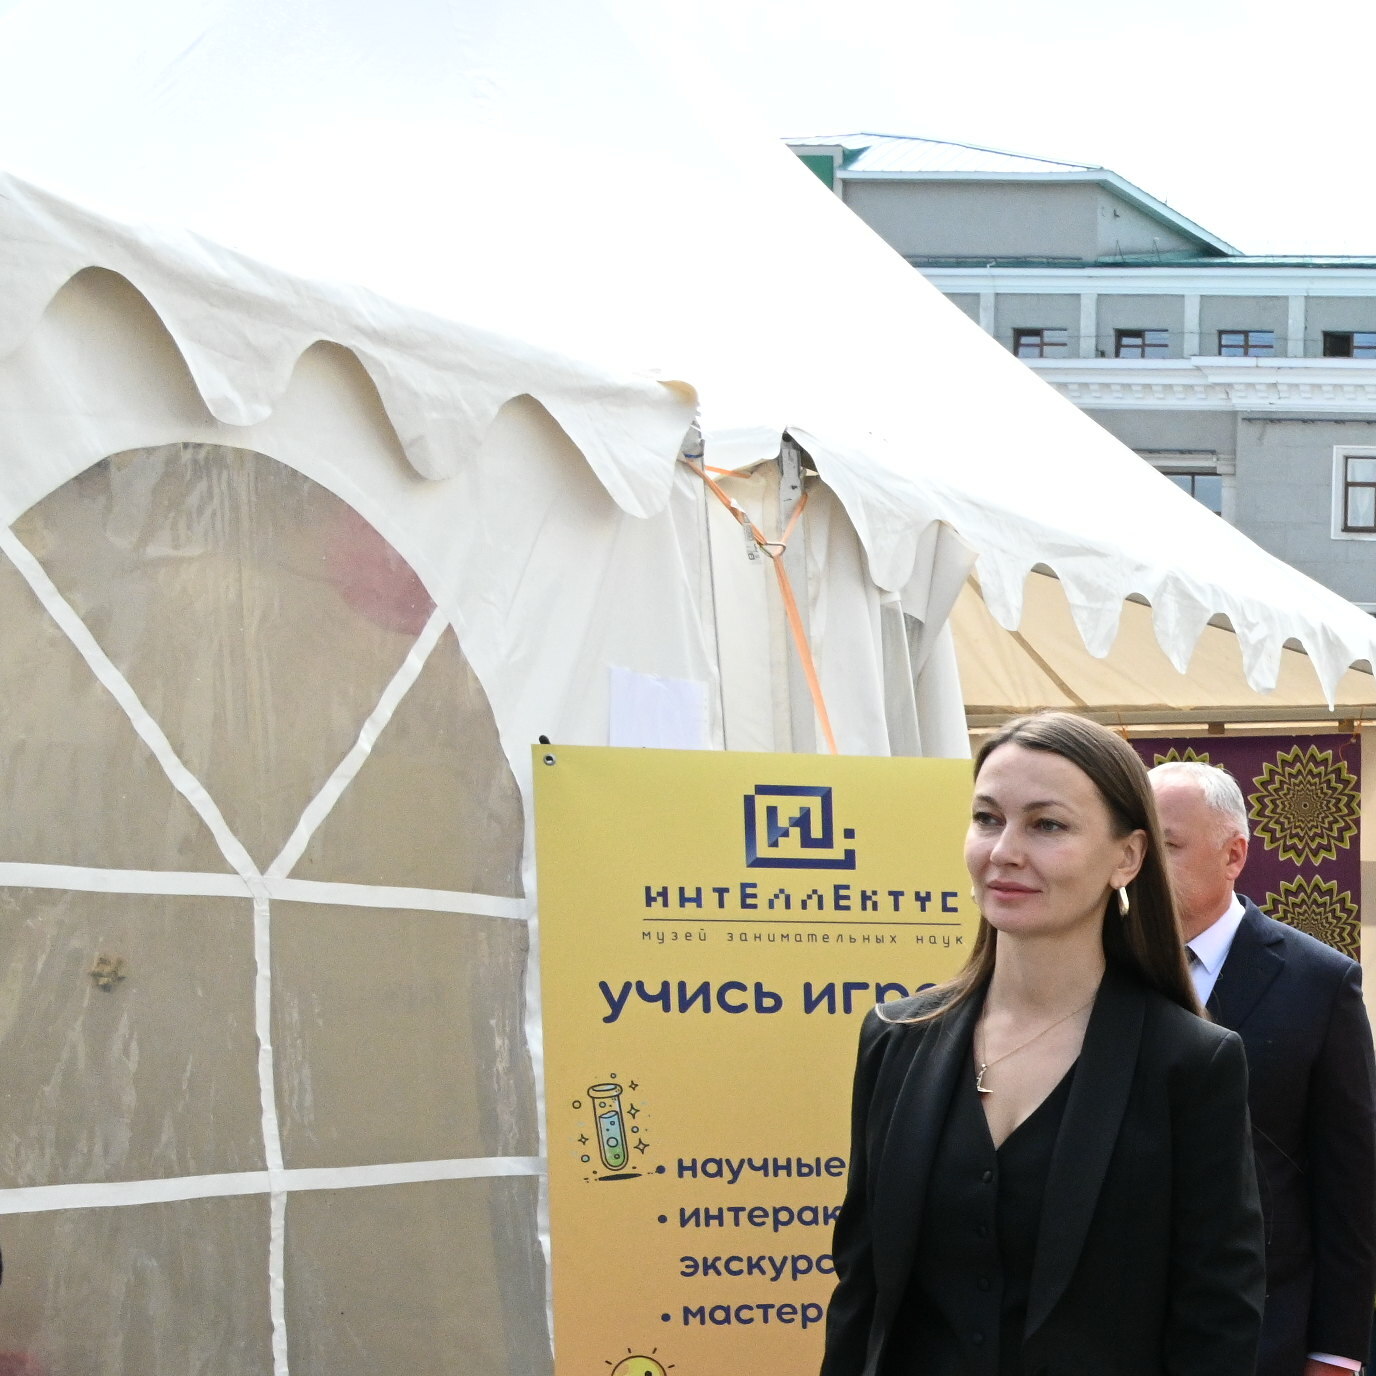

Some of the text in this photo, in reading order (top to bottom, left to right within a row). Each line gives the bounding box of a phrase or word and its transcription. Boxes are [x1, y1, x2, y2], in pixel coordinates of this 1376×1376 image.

[642, 928, 964, 948] музей занимательных наук
[677, 1156, 846, 1185] научные
[680, 1253, 837, 1282] экскурс
[682, 1302, 823, 1329] мастер
